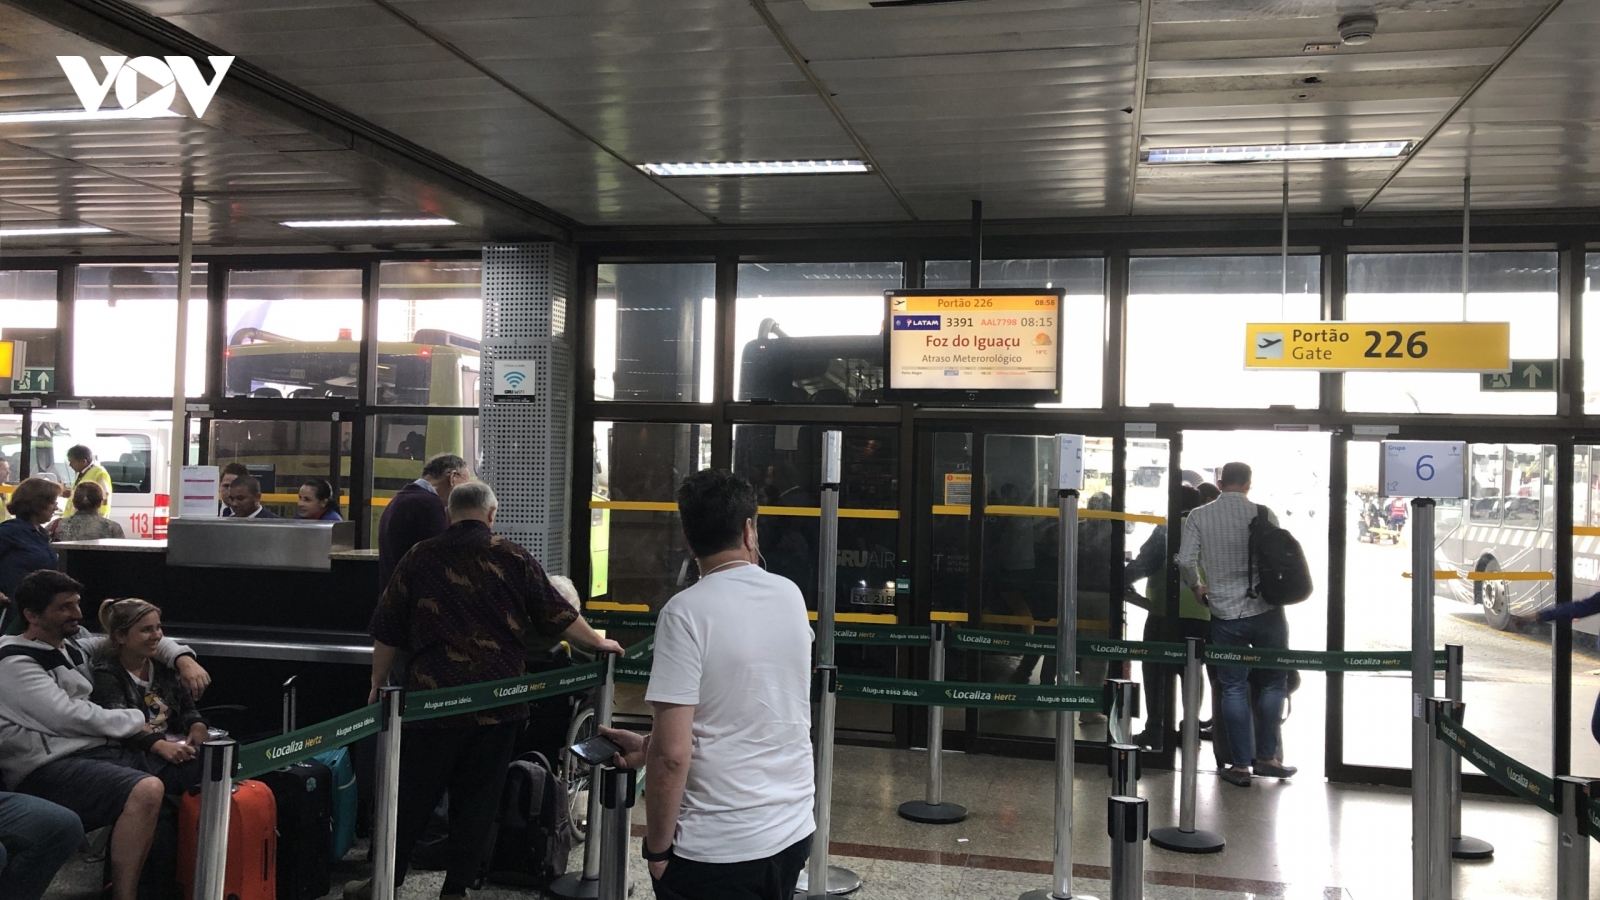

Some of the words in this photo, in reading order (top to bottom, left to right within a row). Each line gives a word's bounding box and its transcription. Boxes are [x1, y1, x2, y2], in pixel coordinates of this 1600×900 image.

[938, 298, 971, 308] Portão
[974, 299, 992, 308] 226
[946, 318, 973, 327] 3391
[1021, 318, 1052, 327] 08:15
[926, 335, 948, 347] Foz
[952, 335, 969, 347] do
[974, 336, 1020, 350] Iguaçu
[1293, 329, 1349, 343] Portão
[1364, 330, 1428, 358] 226
[922, 354, 950, 362] Atraso
[952, 354, 1022, 365] Meterorológico
[1292, 347, 1332, 360] Gate
[1416, 455, 1435, 481] 6
[130, 513, 149, 534] 113
[963, 634, 991, 644] Localiza
[1096, 645, 1127, 654] Localiza
[1210, 652, 1241, 661] Localiza
[424, 701, 444, 710] Alugue
[499, 684, 528, 697] Localiza
[529, 682, 546, 691] Hertz
[559, 677, 575, 685] Alugue
[953, 689, 991, 700] Localiza
[272, 740, 304, 759] Localiza
[304, 735, 322, 748] Hertz
[336, 726, 352, 737] Alugue
[352, 722, 363, 730] essa
[1510, 768, 1529, 788] Localiza
